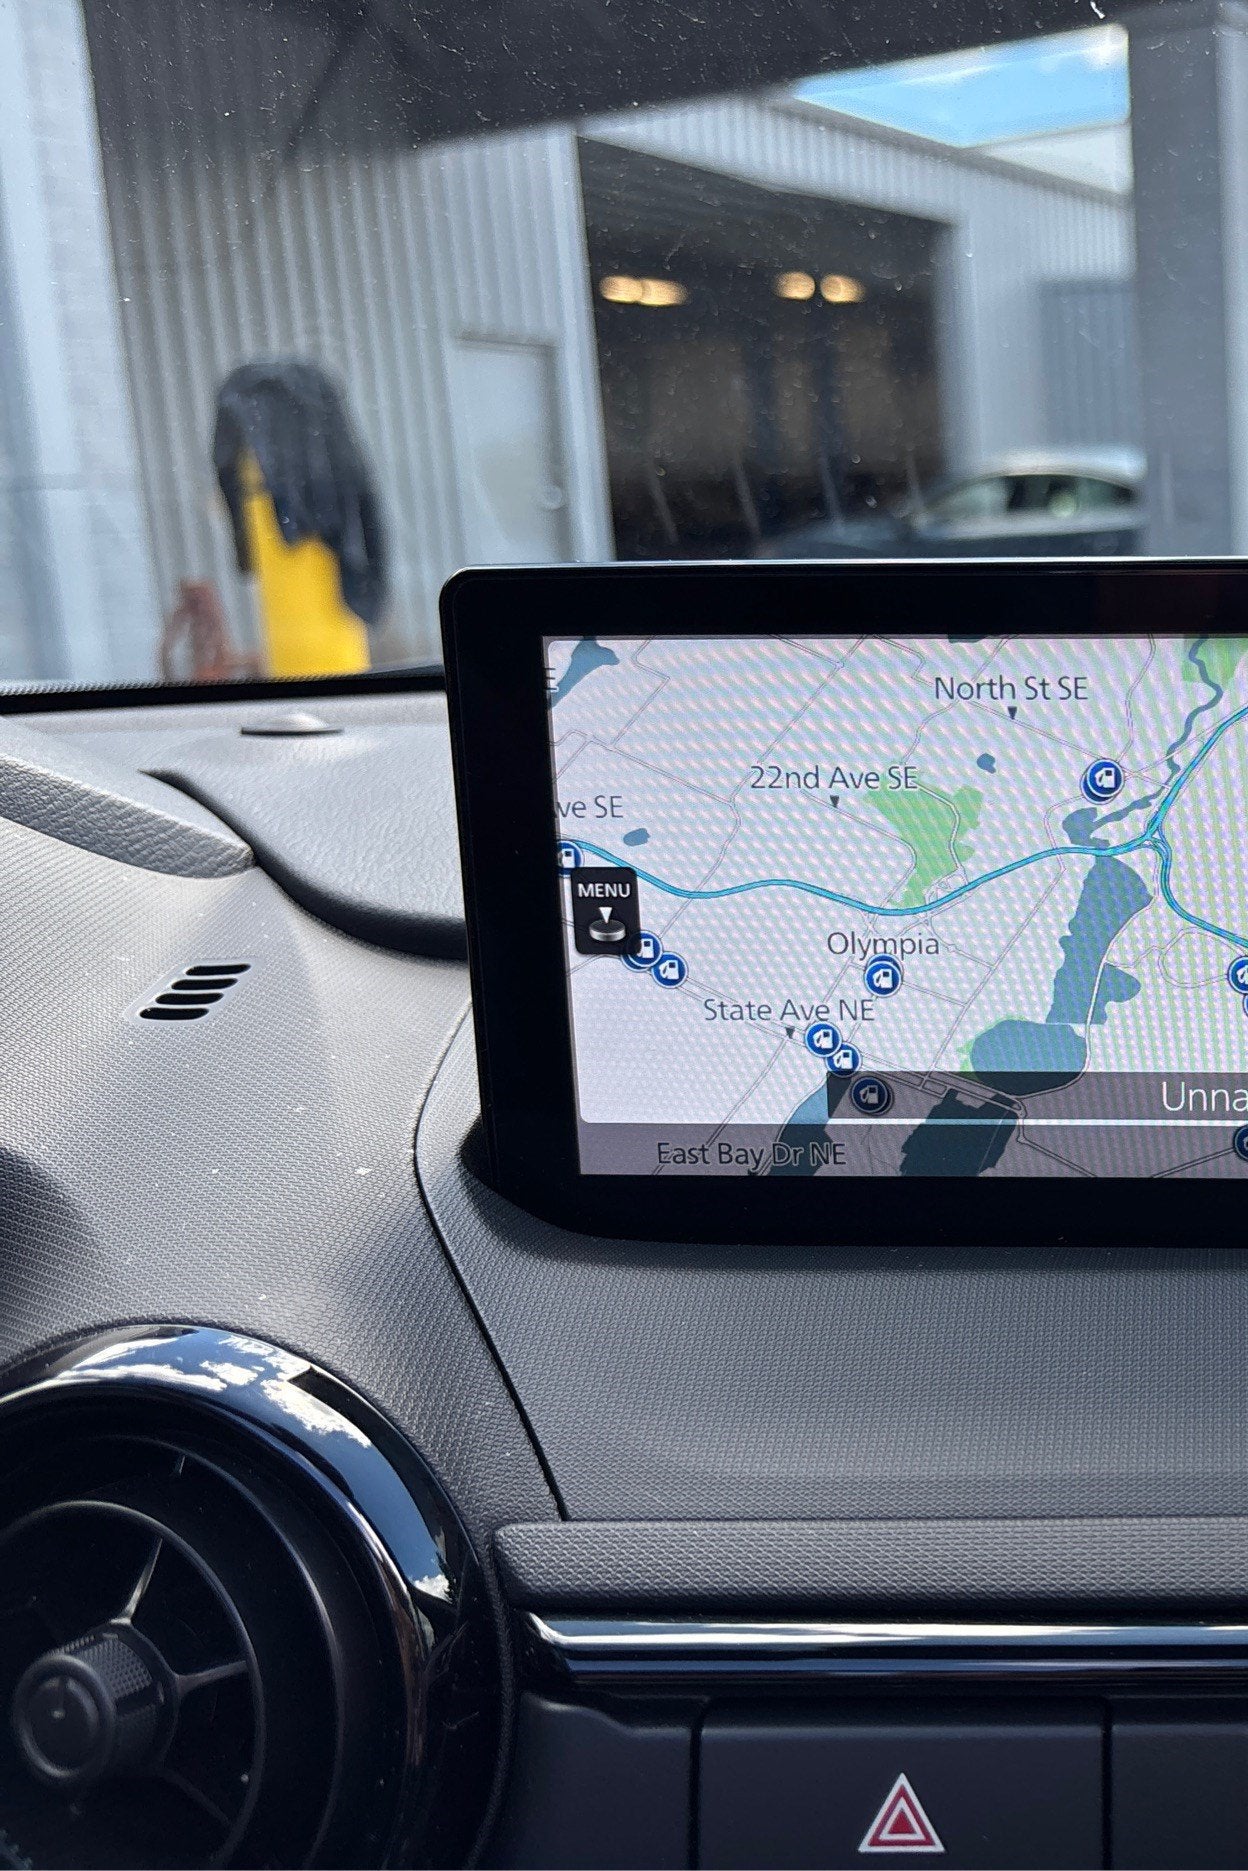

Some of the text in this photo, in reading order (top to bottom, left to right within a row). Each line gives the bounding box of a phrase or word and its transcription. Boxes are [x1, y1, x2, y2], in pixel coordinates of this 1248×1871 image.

[934, 674, 1088, 700] North St SE
[750, 764, 918, 790] 22nd Ave SE
[555, 795, 623, 819] ve SE
[578, 881, 631, 899] MENU
[827, 931, 940, 961] Olympia
[703, 998, 875, 1022] State Ave NE
[657, 1142, 846, 1171] East Bay Dr NE
